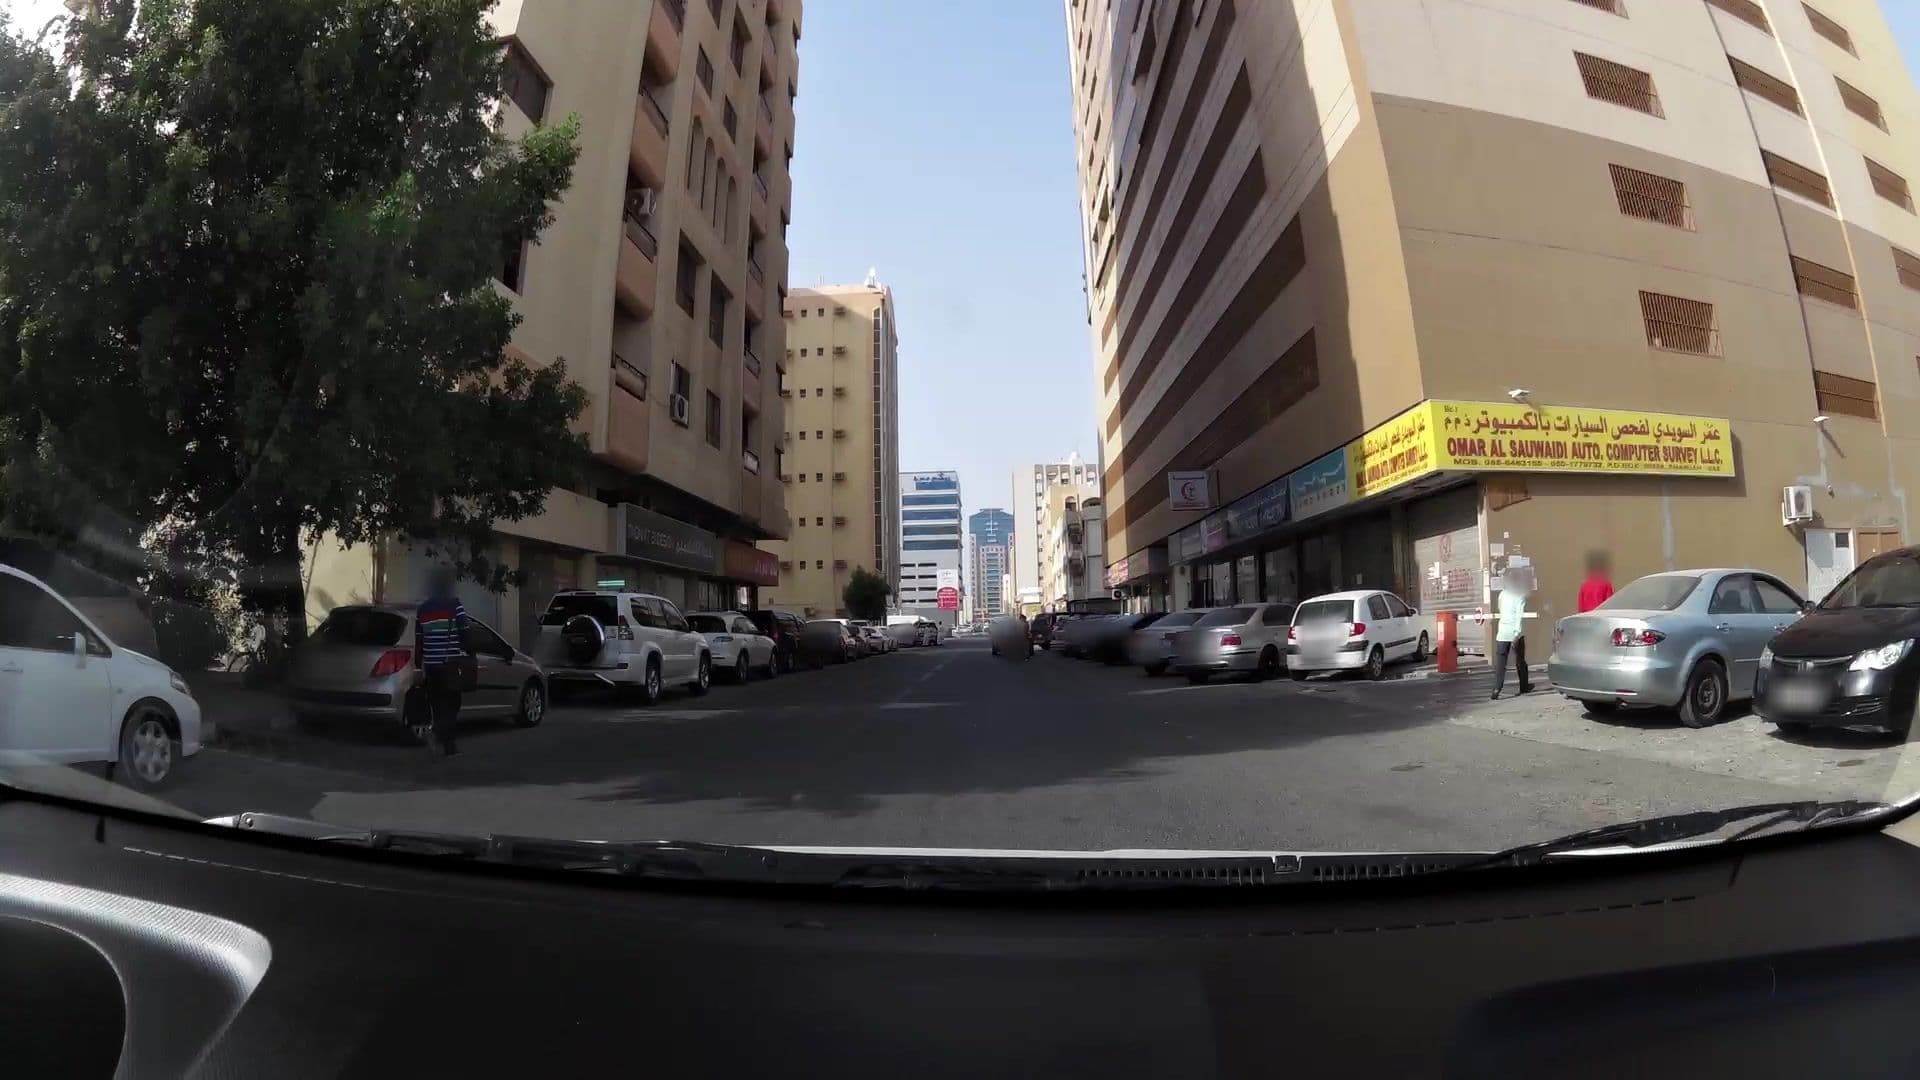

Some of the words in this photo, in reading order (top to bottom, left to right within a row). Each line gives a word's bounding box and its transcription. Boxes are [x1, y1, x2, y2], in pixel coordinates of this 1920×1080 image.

[1472, 410, 1551, 436] بالكمبيوتر
[1554, 414, 1608, 438] السيارات
[1611, 418, 1650, 440] لفحص
[1653, 421, 1697, 444] السويدي
[1447, 437, 1487, 457] OMAR
[1490, 439, 1506, 458] AL
[1510, 440, 1568, 459] SAUWAIDI
[1606, 443, 1660, 462] COMPUTER
[1663, 446, 1697, 464] SURVEY
